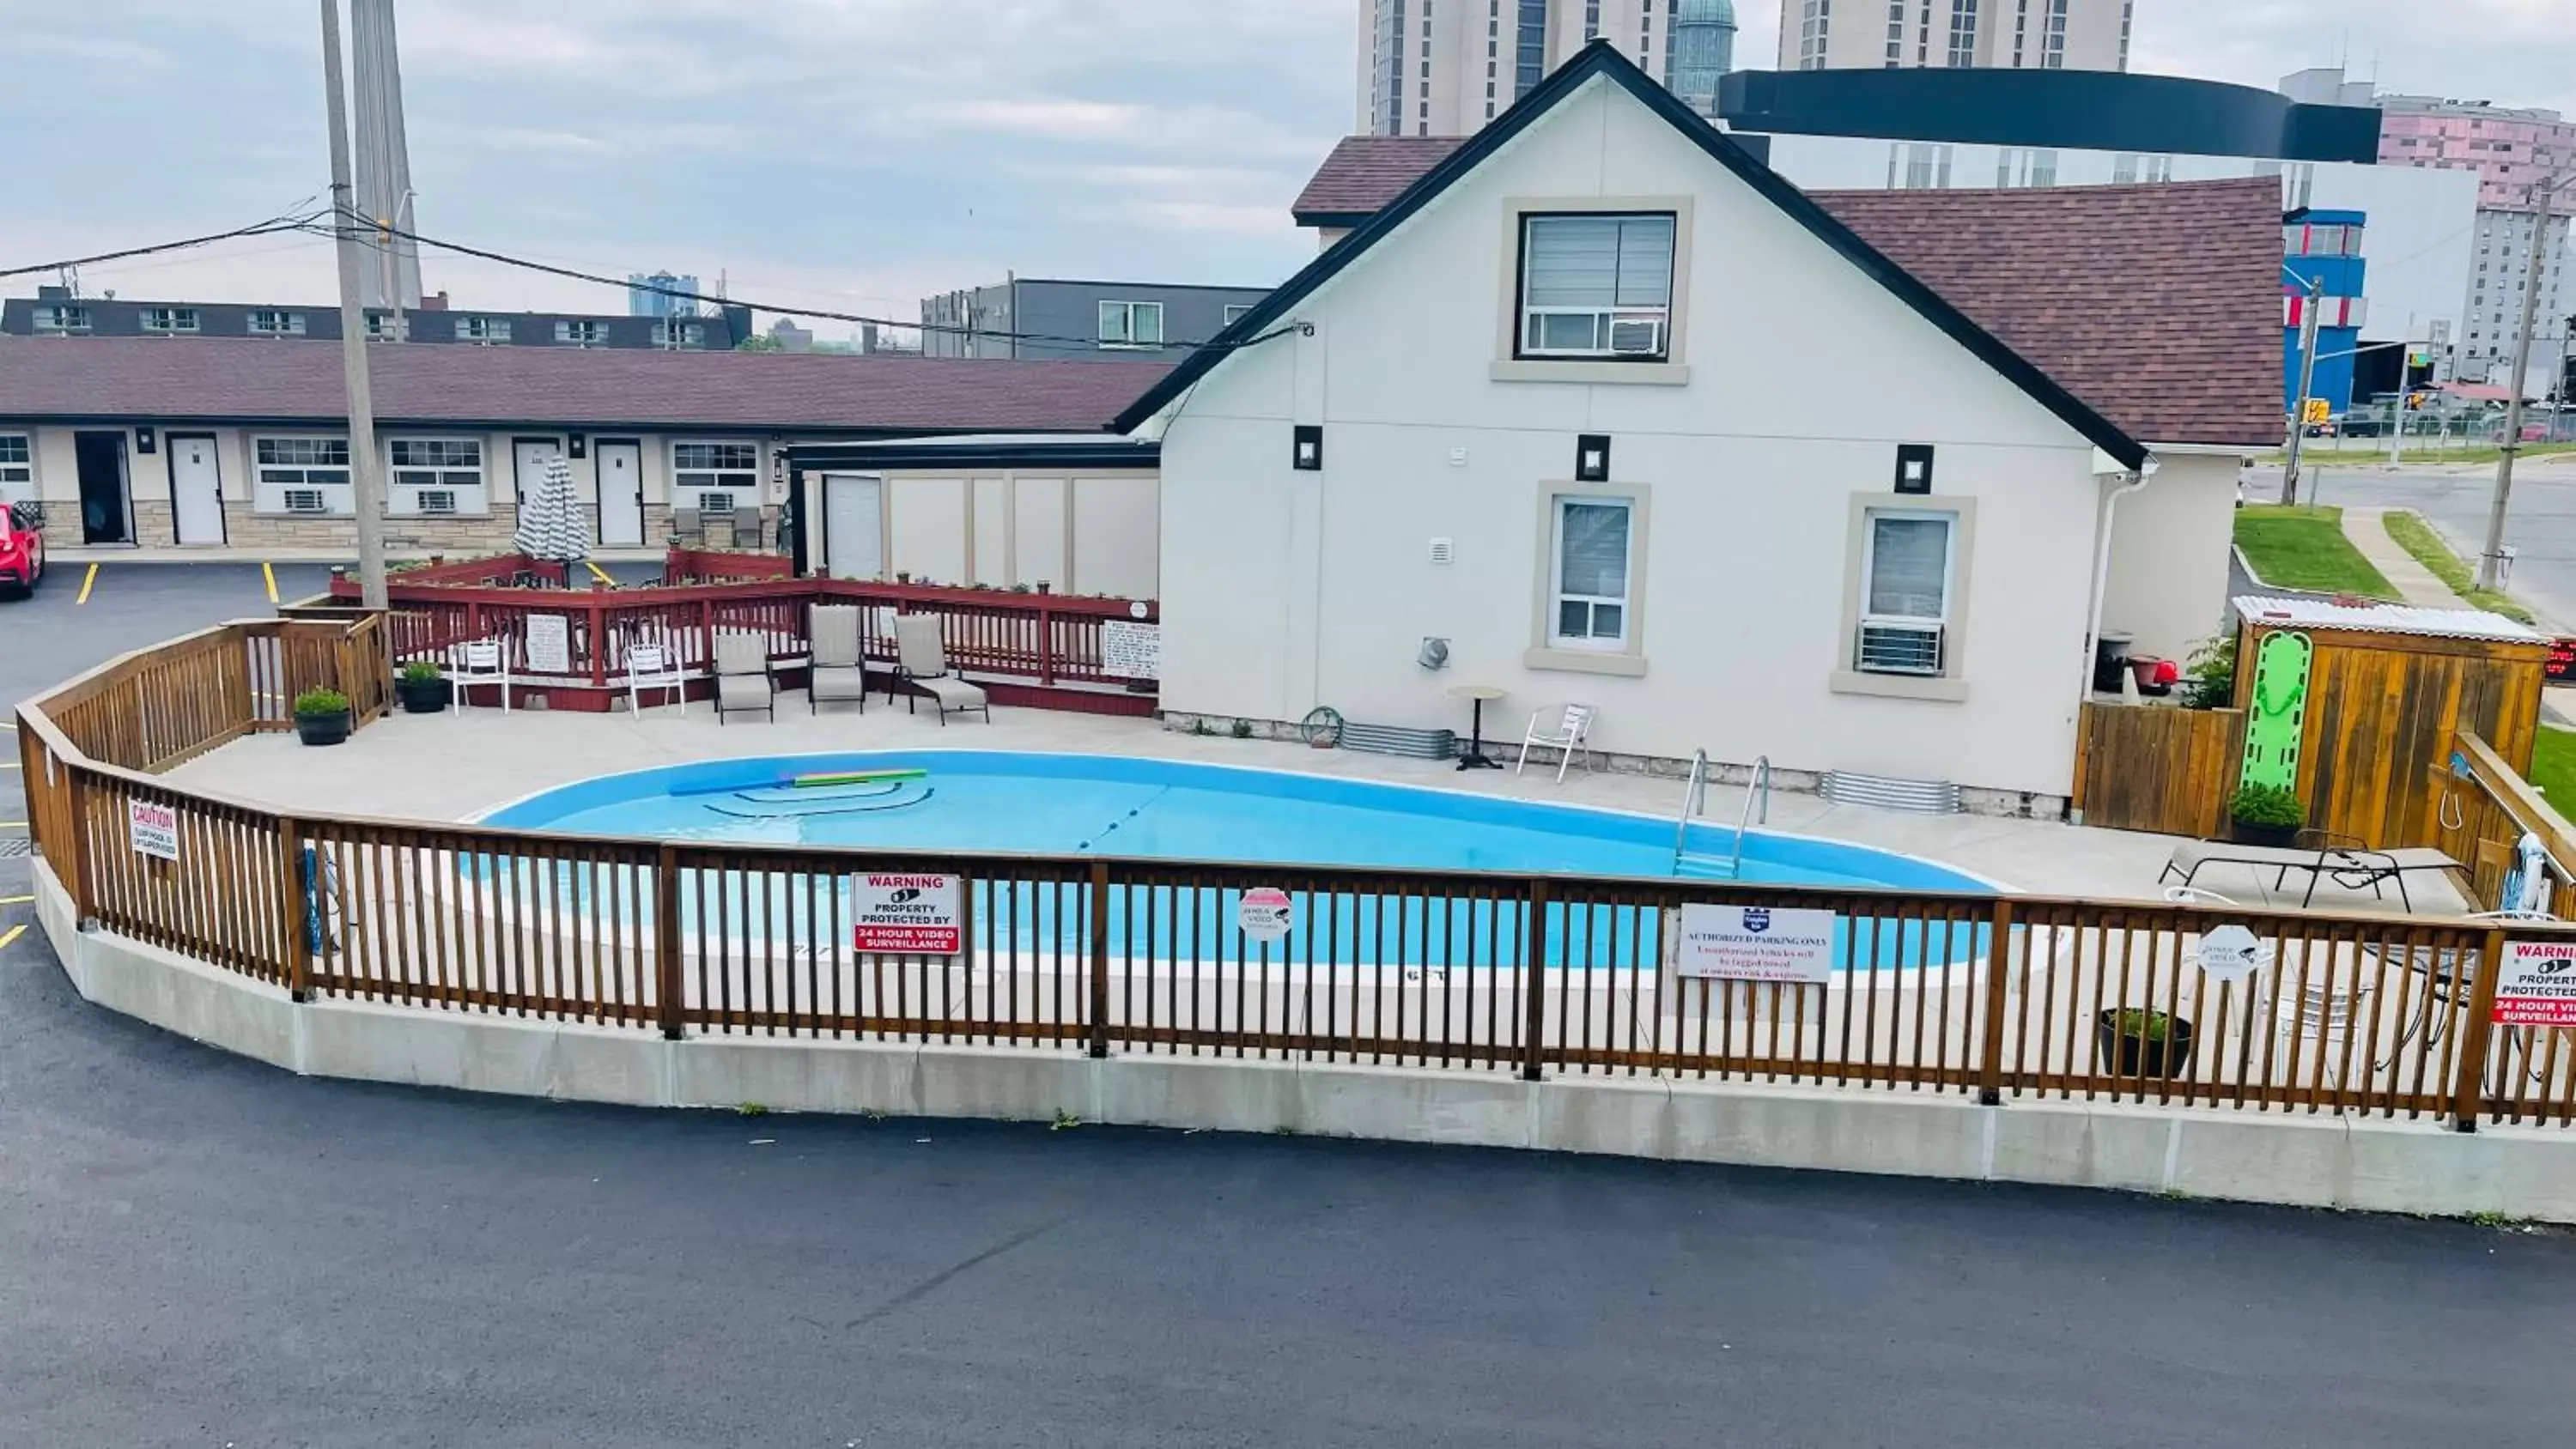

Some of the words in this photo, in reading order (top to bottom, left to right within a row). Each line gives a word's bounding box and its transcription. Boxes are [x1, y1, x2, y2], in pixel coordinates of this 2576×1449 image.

[133, 804, 173, 829] CAUTION
[867, 876, 944, 888] WARNING
[875, 903, 937, 912] PROPERTY
[861, 914, 931, 925] PROTECTED
[933, 916, 951, 925] BY
[859, 929, 873, 937] 24
[876, 930, 913, 938] HOUR
[915, 930, 955, 939] VIDEO
[1688, 932, 1753, 944] AUTHORIZED
[1755, 935, 1799, 946] PARKING
[1801, 937, 1827, 947] ONLY
[866, 938, 949, 949] SURVEILLANCE
[2516, 945, 2576, 958] WARNI
[2502, 985, 2576, 996] PROTECTED
[2496, 1000, 2512, 1009] 24
[2515, 1002, 2556, 1011] HOUR
